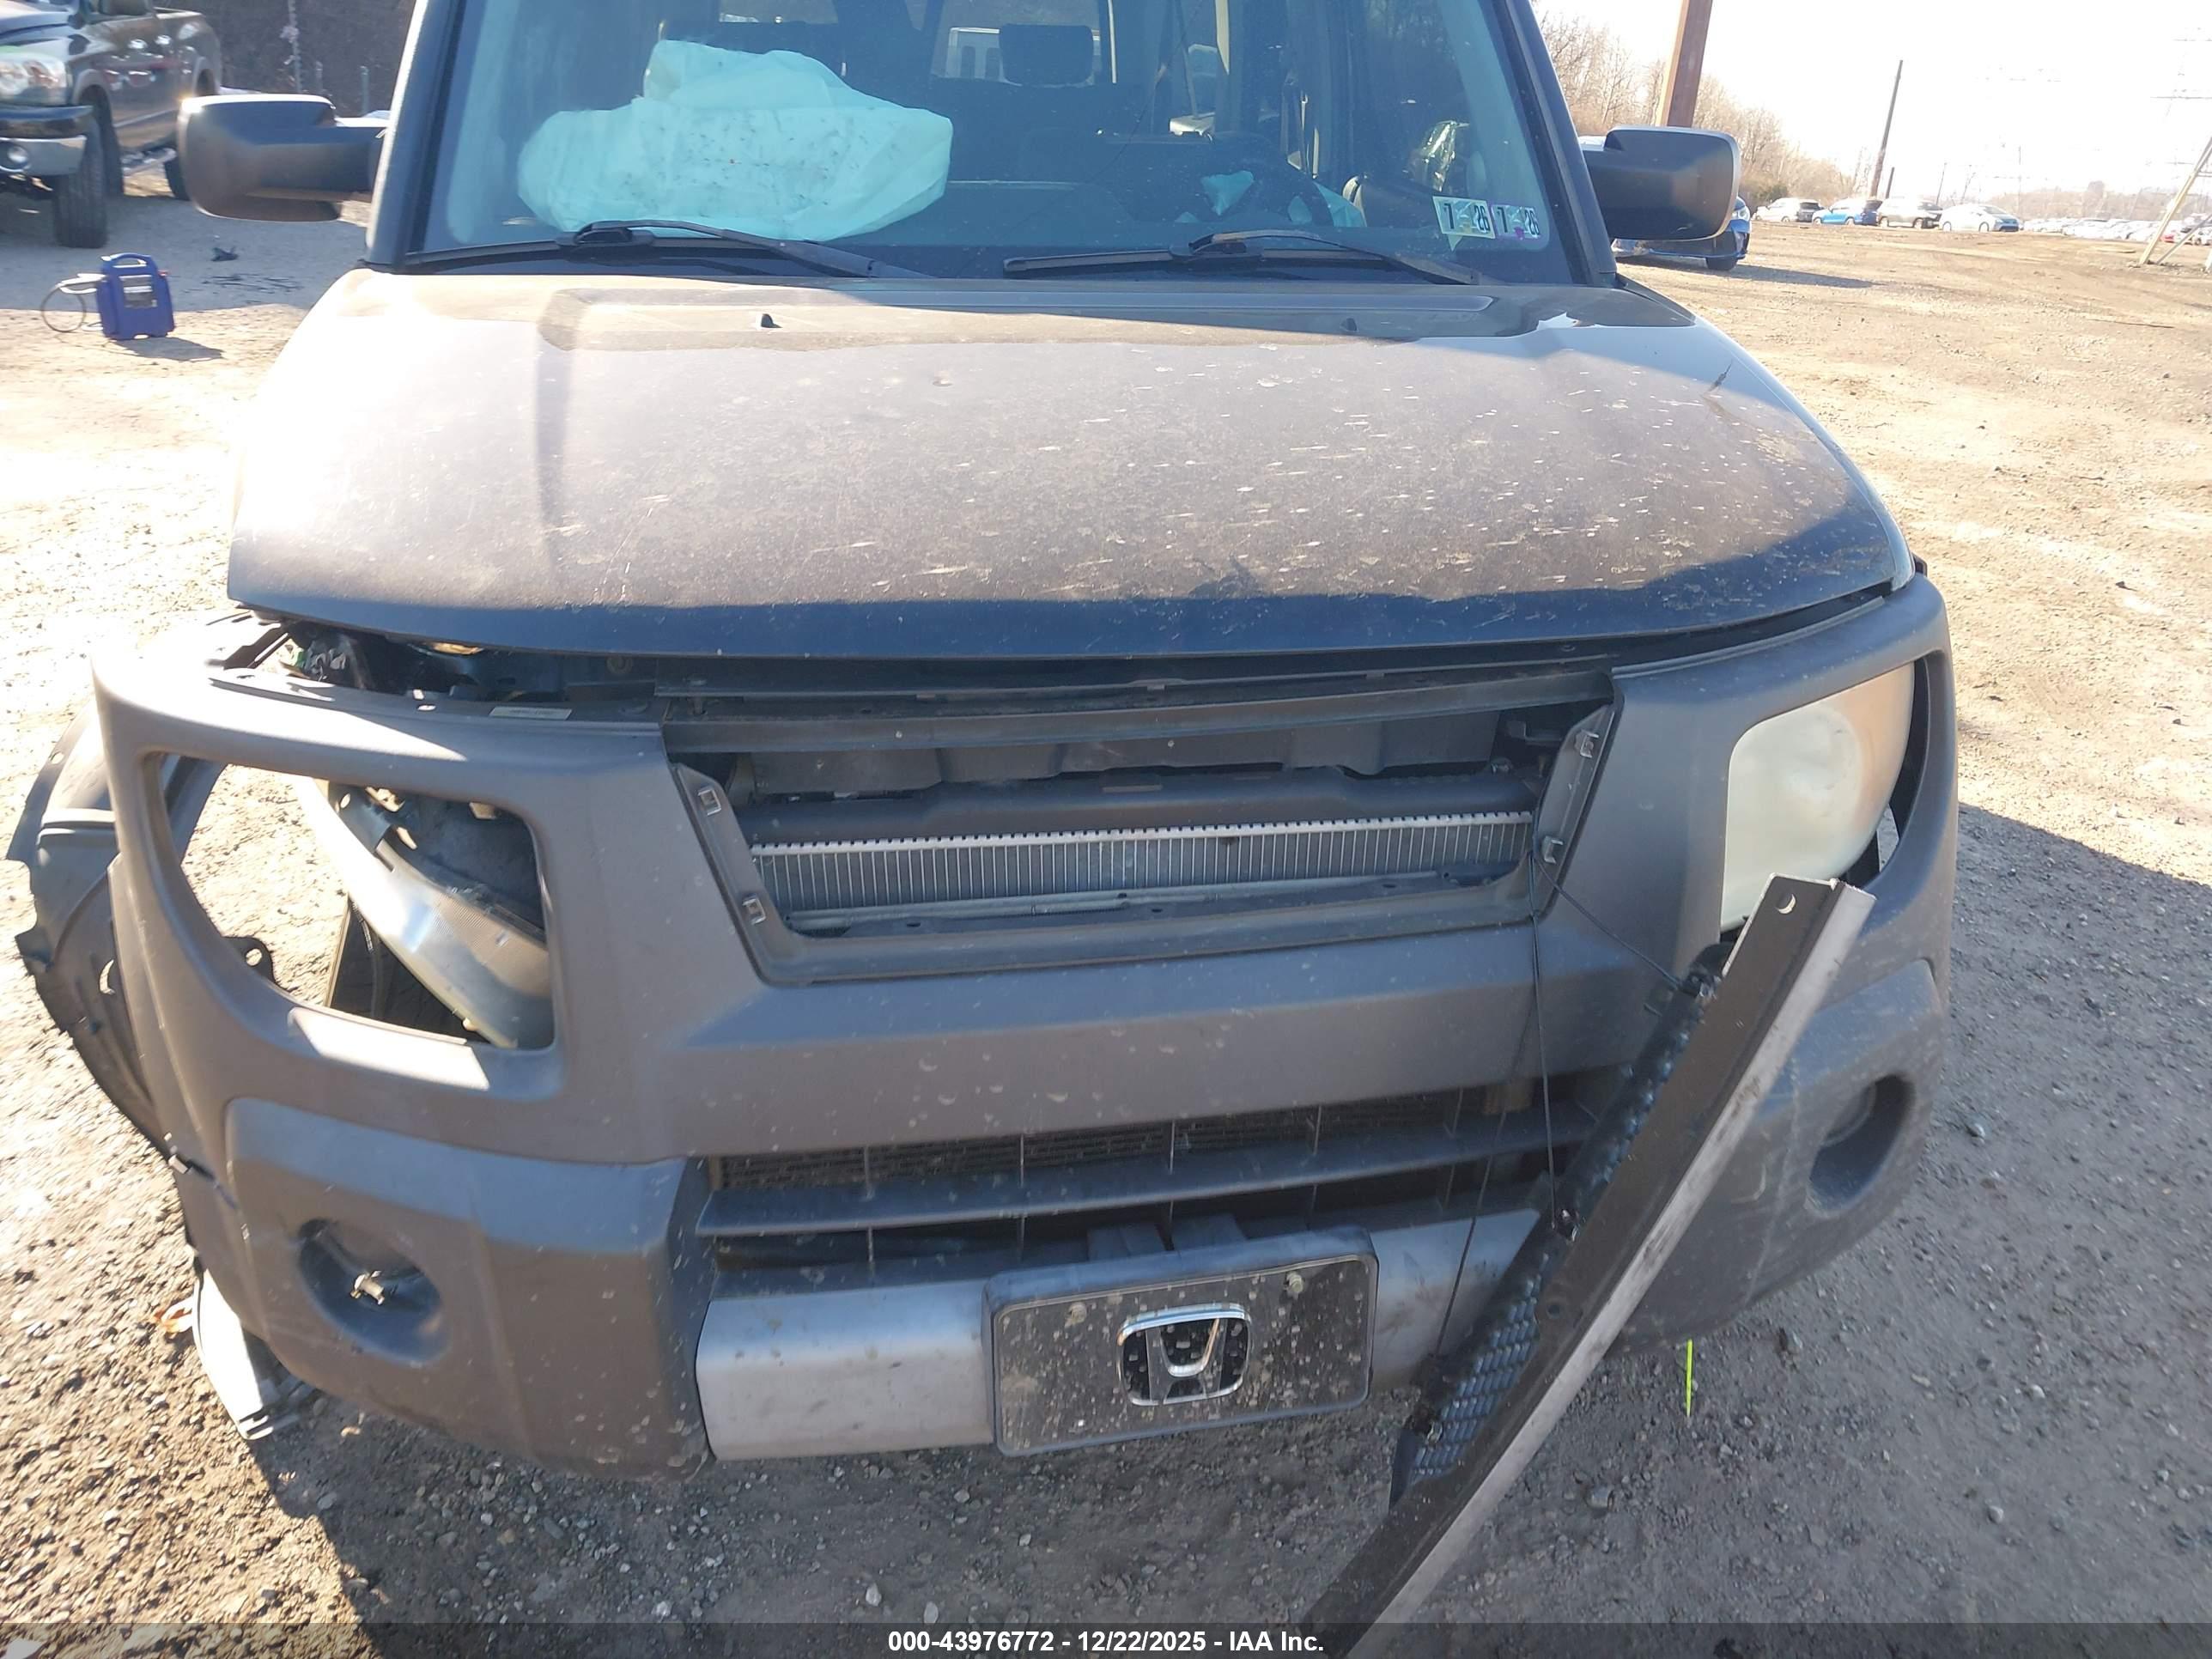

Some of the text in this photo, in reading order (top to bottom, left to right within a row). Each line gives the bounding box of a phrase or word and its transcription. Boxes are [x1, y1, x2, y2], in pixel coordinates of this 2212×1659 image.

[1443, 203, 1491, 232] 7 26
[1497, 206, 1508, 234] 7
